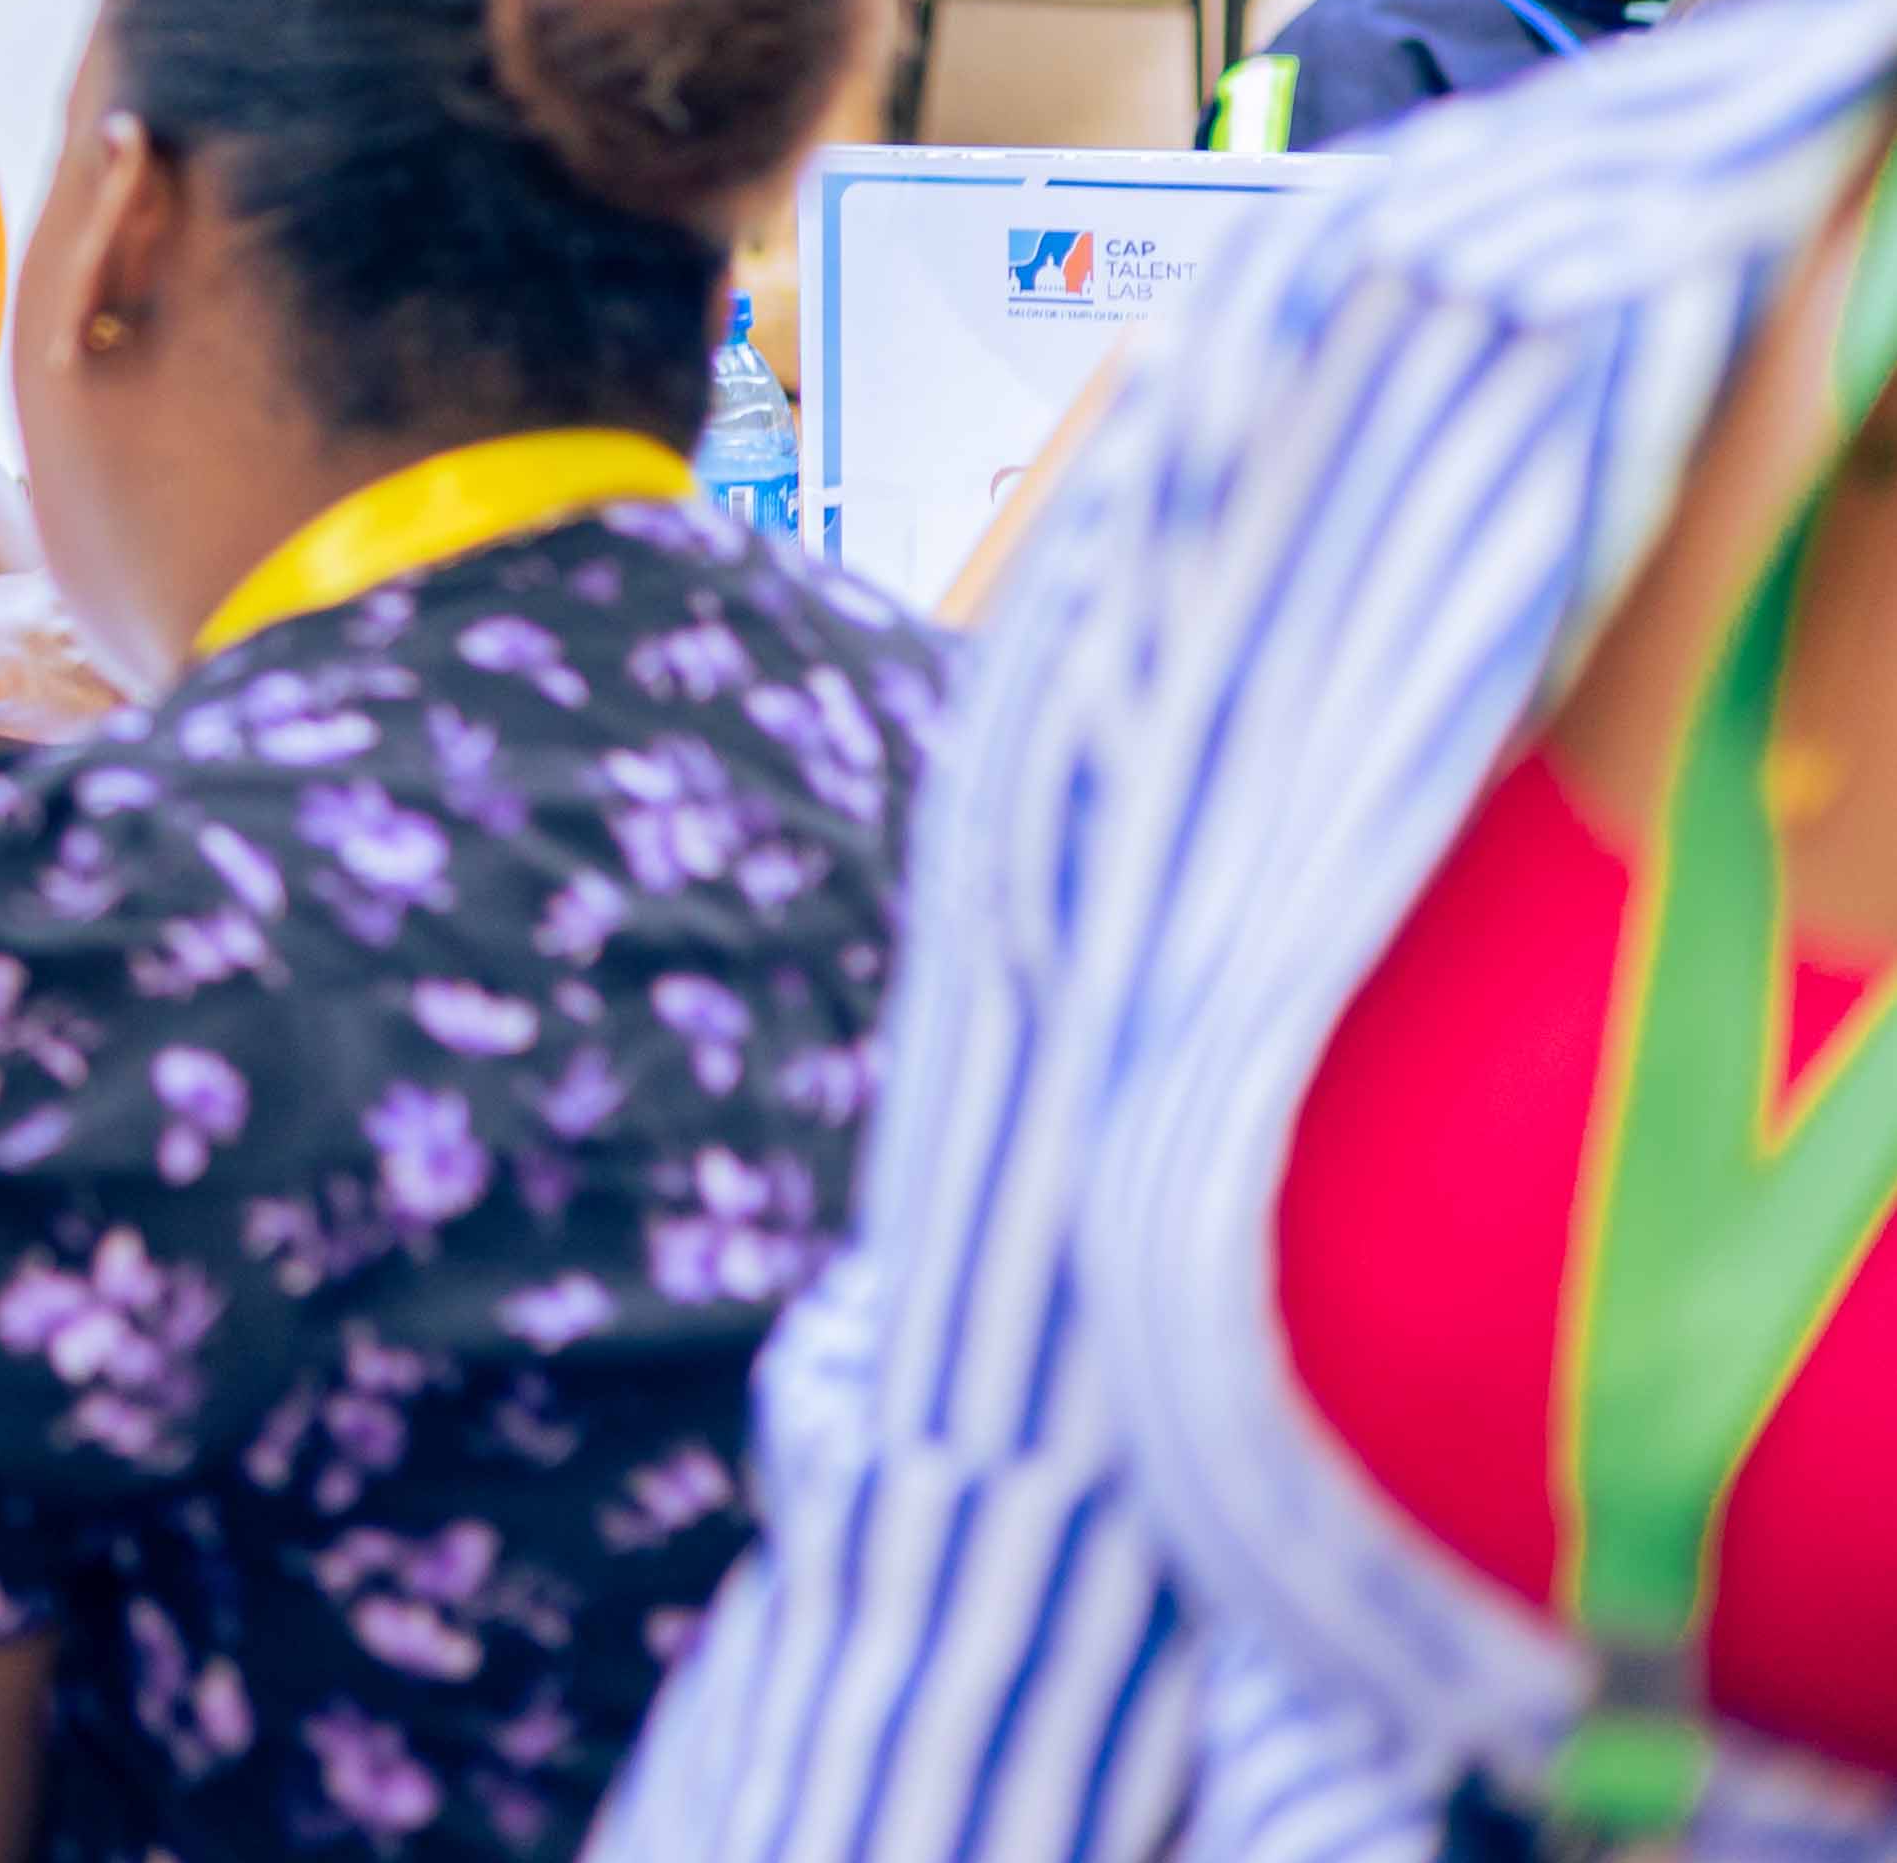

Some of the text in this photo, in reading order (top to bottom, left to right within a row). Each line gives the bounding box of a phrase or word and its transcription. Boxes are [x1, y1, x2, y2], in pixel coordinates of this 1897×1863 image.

[1106, 239, 1156, 257] CAP
[1106, 261, 1197, 281] TALENT
[1106, 283, 1154, 302] LAB
